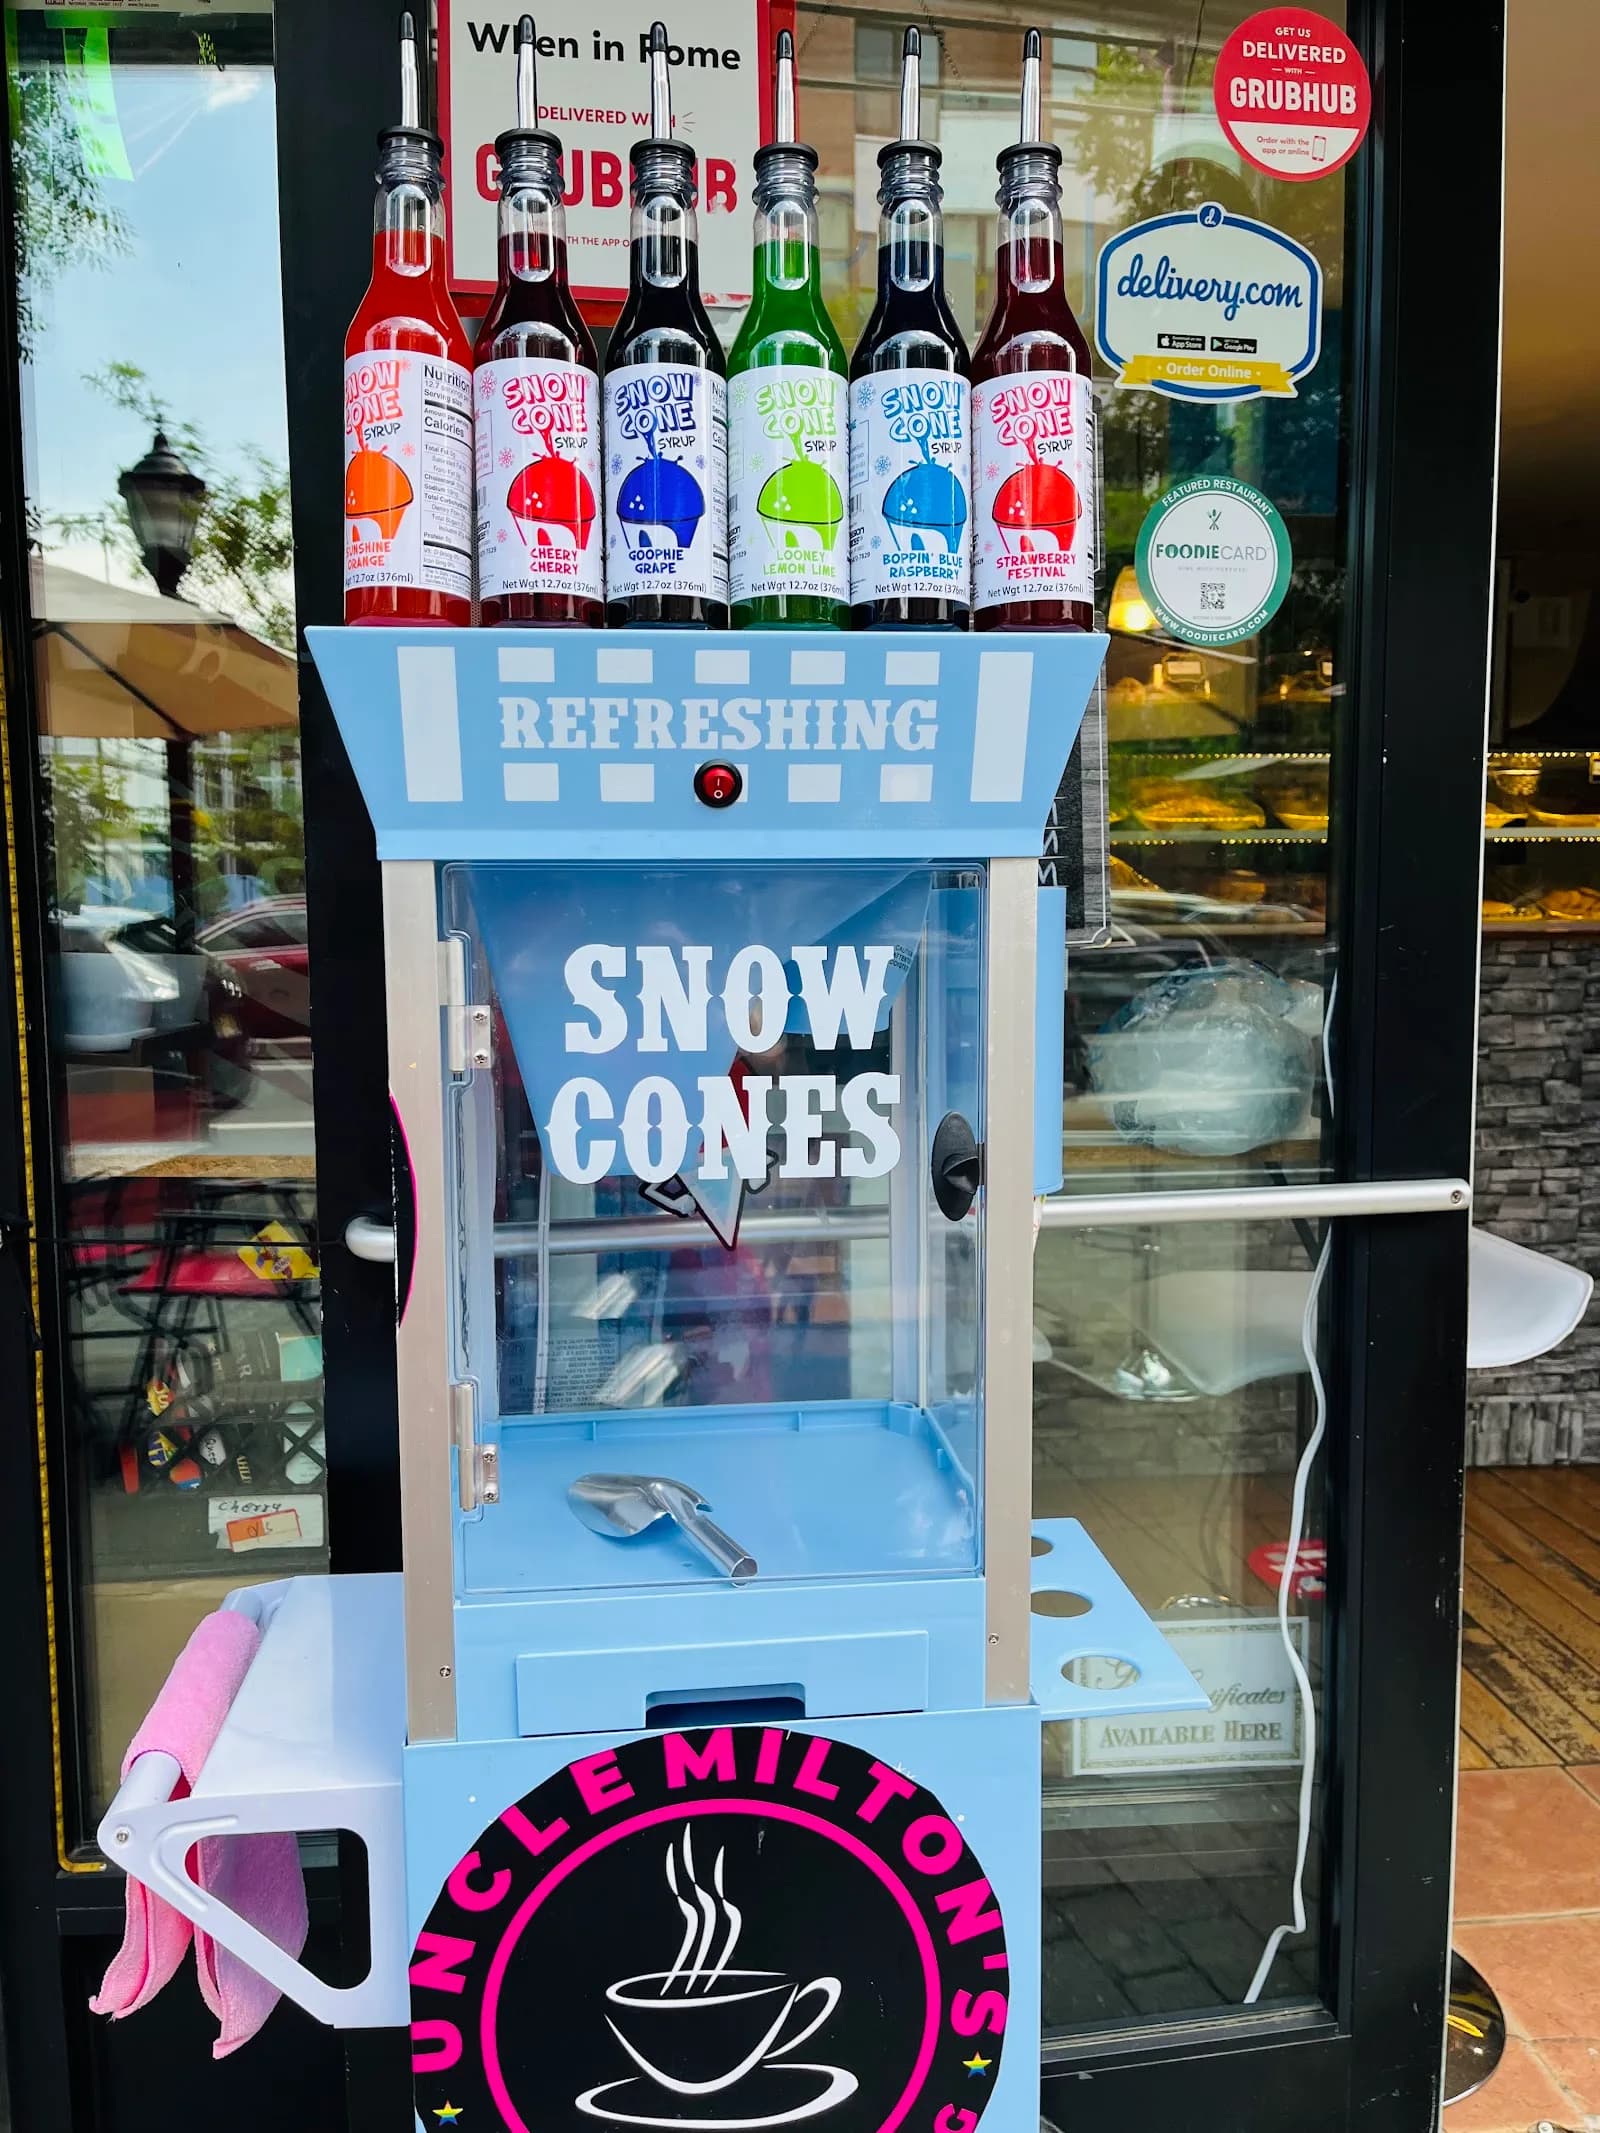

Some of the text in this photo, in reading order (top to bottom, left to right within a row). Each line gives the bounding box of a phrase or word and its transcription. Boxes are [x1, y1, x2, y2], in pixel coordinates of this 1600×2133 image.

[1275, 27, 1312, 38] GET US
[592, 30, 624, 62] in
[1242, 40, 1346, 64] DELIVERED
[1284, 67, 1303, 75] WITH
[1230, 76, 1357, 115] GRUBHUB
[538, 105, 676, 128] DELIVERED WH
[1256, 135, 1310, 146] Order with the
[1262, 147, 1276, 156] app
[1287, 148, 1310, 156] online
[475, 143, 738, 214] GUBB
[567, 236, 630, 248] TH THE APP O
[1117, 253, 1303, 321] delivery.com
[1172, 340, 1202, 349] App Store
[1223, 343, 1255, 352] Google Play
[1166, 362, 1252, 379] Order Online
[346, 360, 400, 403] NOW
[502, 372, 587, 410] SNOW
[614, 372, 695, 417] SNOW
[754, 376, 837, 415] SNOW
[881, 380, 962, 419] SNOW
[990, 377, 1071, 425] SNOW
[424, 416, 465, 438] Calories
[511, 403, 588, 435] CONE
[620, 401, 696, 440] CONE
[762, 406, 838, 440] CONE
[889, 410, 962, 443] CONE
[997, 406, 1075, 447] CONE
[363, 422, 401, 441] SYRUP
[554, 436, 589, 450] SYRUP
[657, 435, 696, 450] SYRUP
[804, 440, 837, 453] SYRUP
[931, 441, 962, 455] SYRUP
[1037, 439, 1073, 456] SYRUP
[1161, 479, 1273, 516] FEATURED RESTAURANT
[530, 547, 578, 562] CHEERY
[628, 548, 685, 562] GOOPHIE
[776, 549, 826, 562] LOONEY
[882, 552, 934, 566] BOPPIN'
[938, 553, 963, 569] BLUE
[1156, 543, 1267, 561] FOODIECARD
[347, 555, 385, 570] ORANGE
[529, 561, 579, 575] CHERRY
[634, 562, 677, 575] GRAPE
[763, 561, 837, 578] LEMON LIME
[996, 553, 1077, 569] STRAWBERRY
[377, 572, 414, 584] (376ml)
[889, 566, 960, 580] RASPBERRY
[1007, 566, 1067, 581] FESTIVAL
[502, 578, 517, 590] Net
[519, 578, 538, 592] Wgt
[541, 578, 572, 590] 12.7oz
[612, 583, 623, 593] Net
[623, 581, 639, 593] Wgt
[641, 579, 672, 590] 12.7oz
[751, 582, 766, 593] Net
[767, 581, 787, 594] Wgt
[789, 580, 819, 592] 12.7oz
[875, 583, 890, 594] Net
[891, 582, 912, 596] Wgt
[913, 581, 943, 593] 12.7oz
[987, 588, 1001, 599] Net
[1002, 586, 1021, 599] Wgt
[1023, 583, 1054, 595] 12.7oz
[1154, 606, 1269, 642] WWW.FOODIECARD.COM
[499, 697, 940, 751] REFRESHING
[563, 943, 895, 1054] SNOW
[544, 1071, 901, 1185] CONES
[1208, 1682, 1286, 1714] tificates
[1101, 1719, 1282, 1748] AVAILABLE HERE
[408, 1727, 1009, 2074] UNCLE MILTON'S
